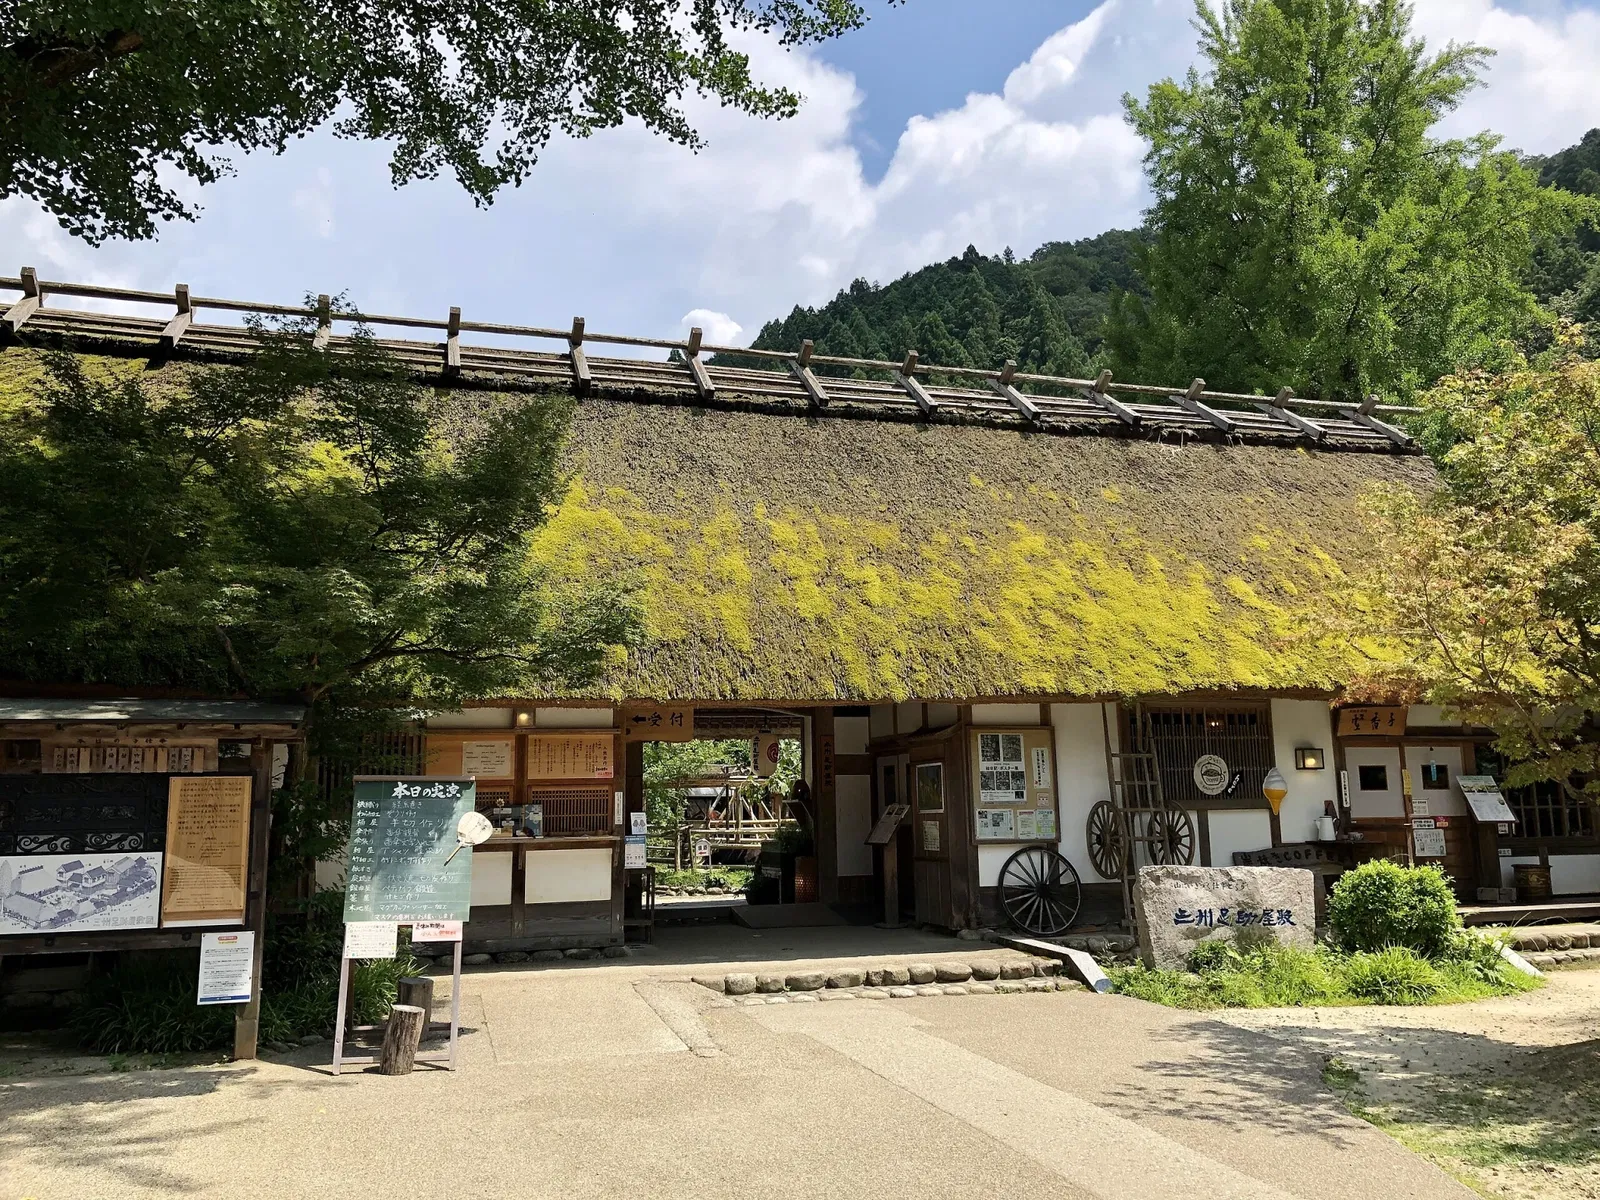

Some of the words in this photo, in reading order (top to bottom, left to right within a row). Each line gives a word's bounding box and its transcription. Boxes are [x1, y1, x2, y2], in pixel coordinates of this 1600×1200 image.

[650, 711, 684, 727] 受付
[391, 781, 461, 799] 本日の実演
